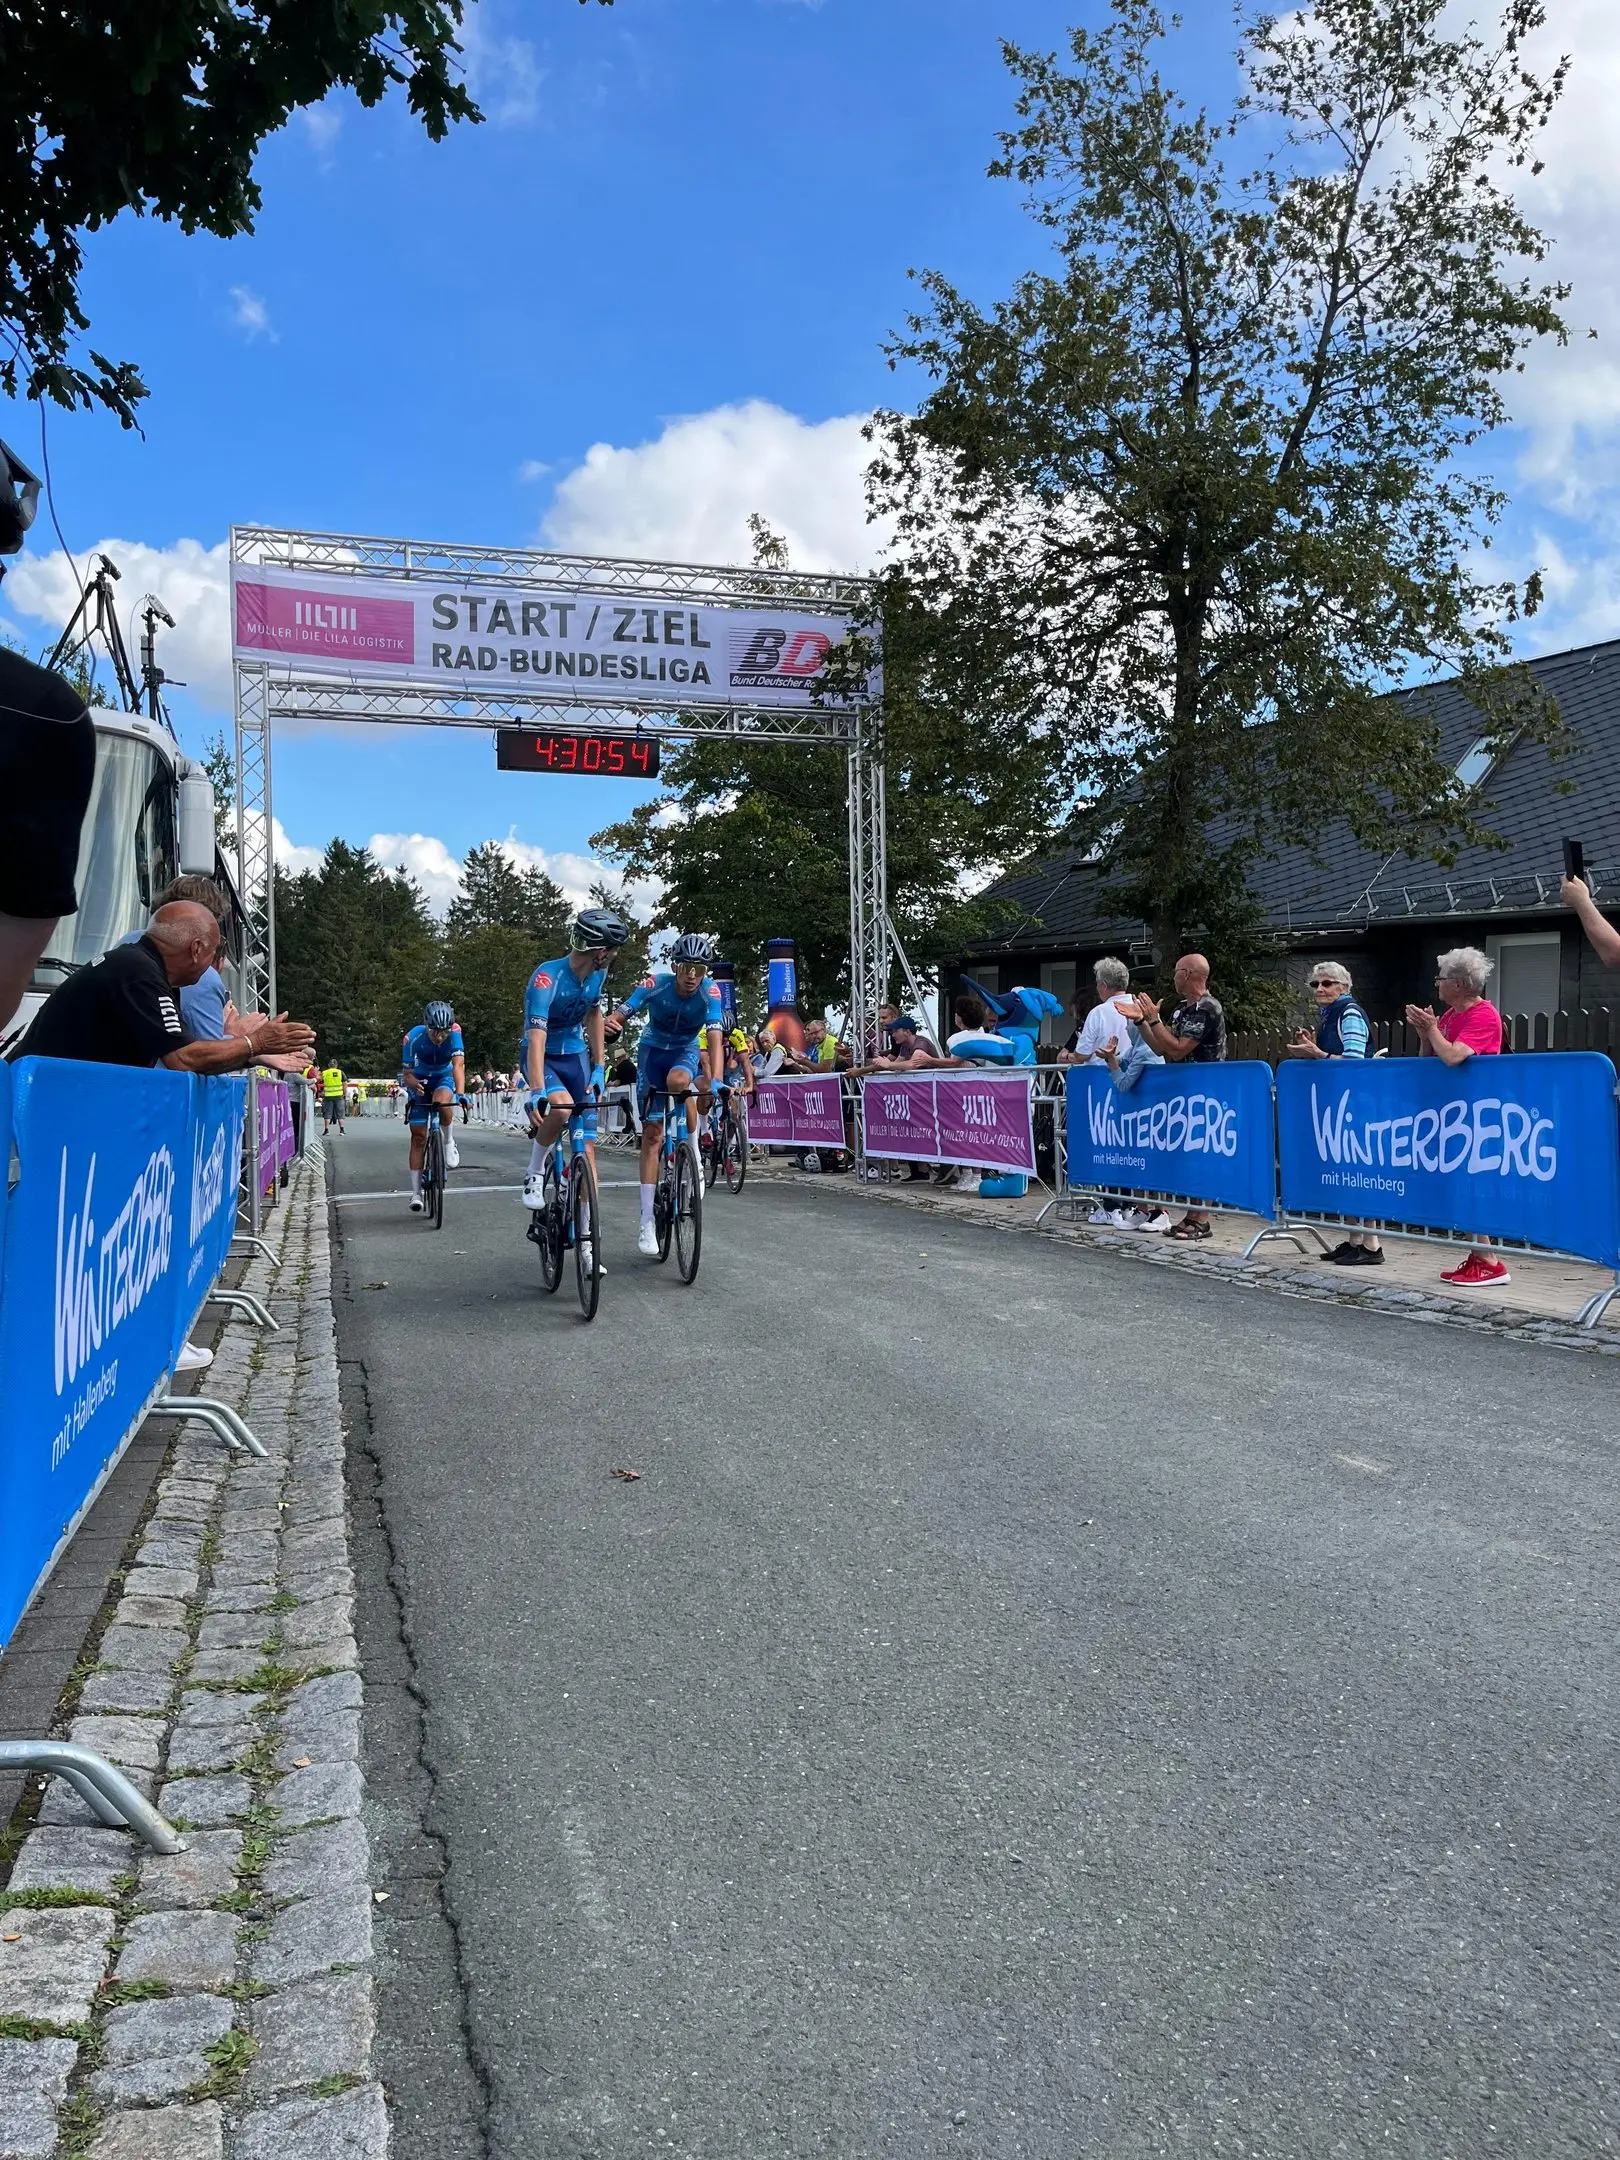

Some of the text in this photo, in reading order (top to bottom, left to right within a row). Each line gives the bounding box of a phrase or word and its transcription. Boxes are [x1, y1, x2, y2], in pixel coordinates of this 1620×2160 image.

[432, 593, 576, 638] START
[613, 607, 711, 649] ZIEL
[302, 630, 320, 641] DIE
[324, 632, 349, 645] LILA
[353, 635, 404, 649] LOGISTIK
[432, 642, 712, 685] RAD-BUNDESLIGA
[731, 675, 757, 685] Bund
[757, 677, 802, 688] Deutscher
[536, 737, 649, 772] 4:30:54
[1093, 1153, 1146, 1171] mit Hallenberg
[1321, 1172, 1405, 1196] mit Hallenberg
[51, 1359, 118, 1473] mit Hallenberg
